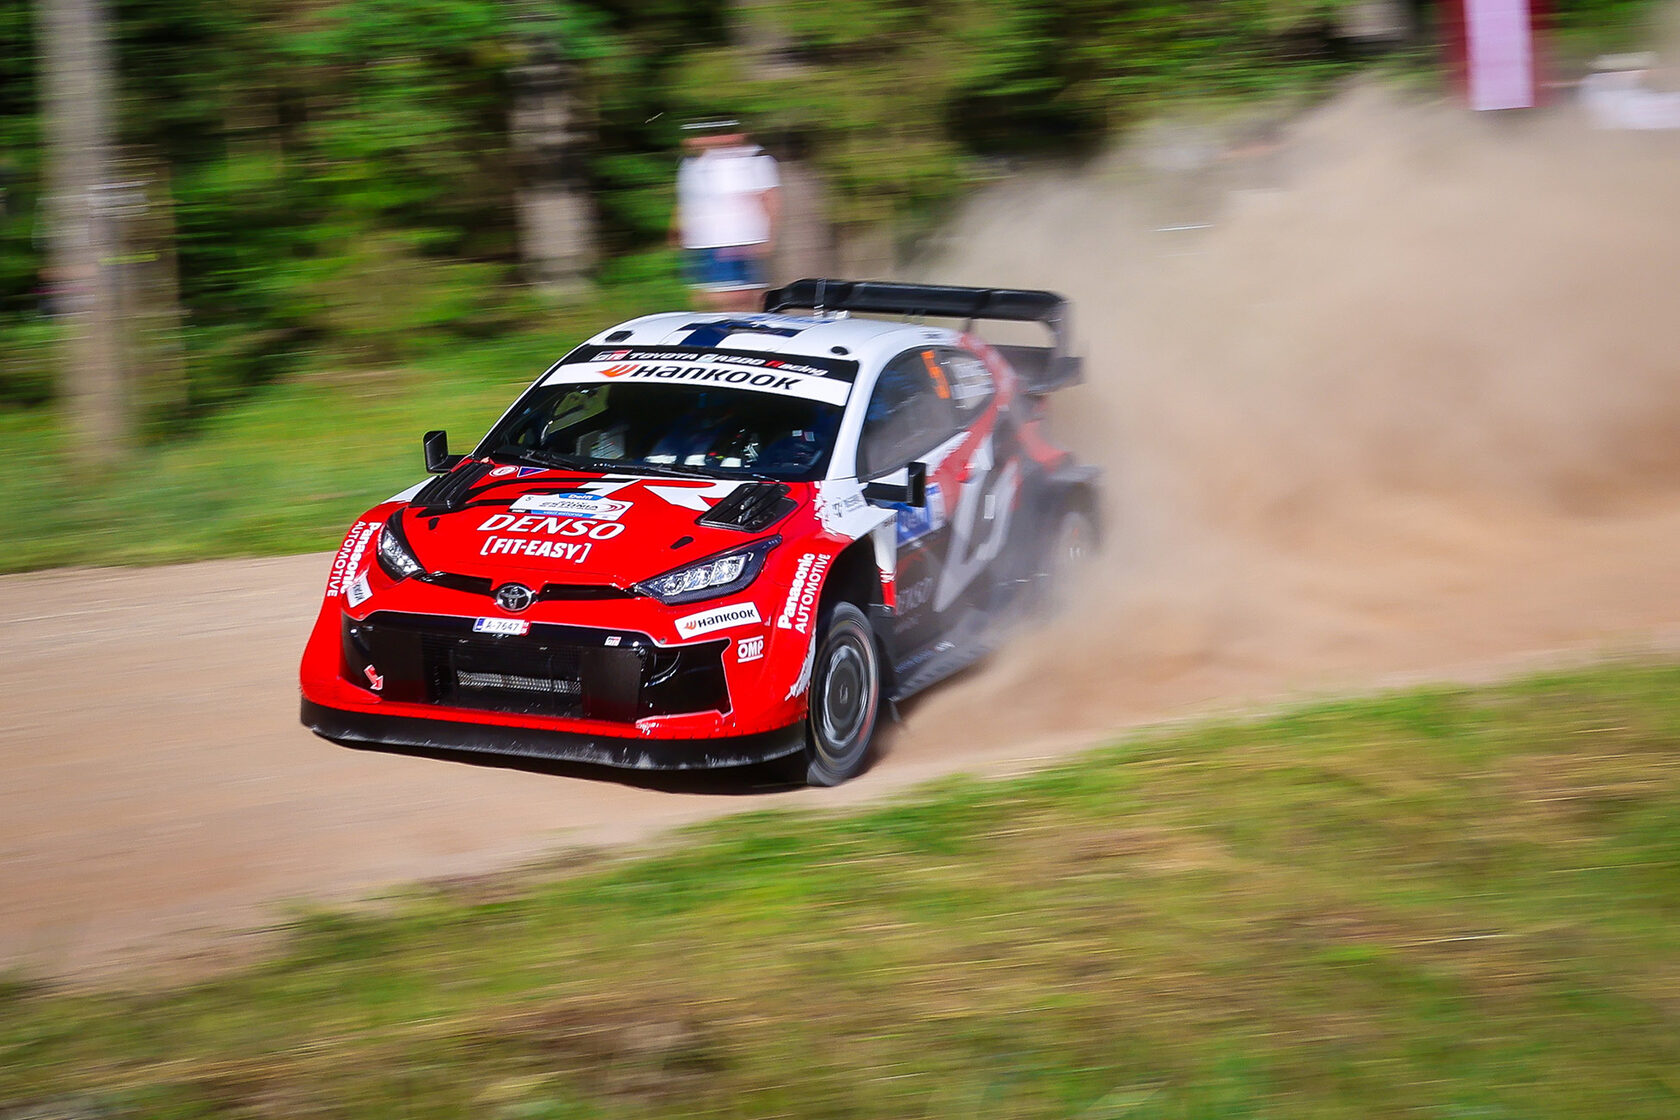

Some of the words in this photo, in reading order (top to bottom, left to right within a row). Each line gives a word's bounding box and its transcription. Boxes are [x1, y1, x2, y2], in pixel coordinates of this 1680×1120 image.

[630, 352, 699, 361] TOYOTA
[696, 353, 767, 366] GAZOO
[764, 360, 828, 376] Racing
[921, 350, 950, 399] 5
[340, 521, 382, 594] Panasonic
[476, 514, 626, 540] DENSO
[326, 520, 366, 597] AUTOMOTIVE
[777, 552, 816, 630] Panasonic
[794, 553, 831, 634] AUTOMOTIVE
[737, 638, 764, 659] OMP
